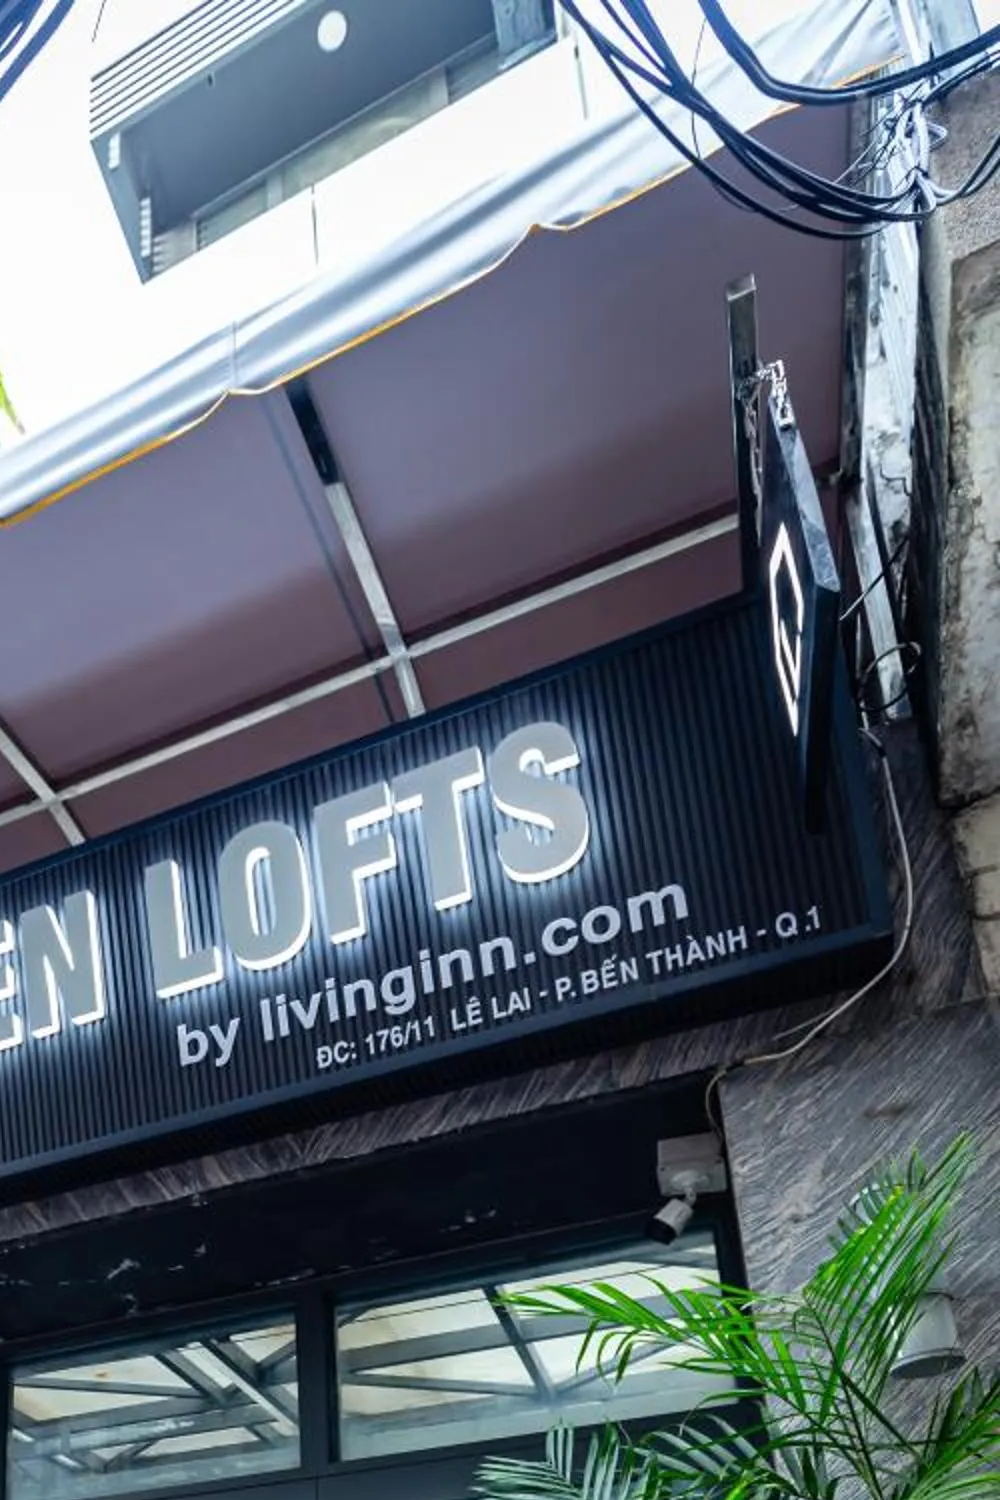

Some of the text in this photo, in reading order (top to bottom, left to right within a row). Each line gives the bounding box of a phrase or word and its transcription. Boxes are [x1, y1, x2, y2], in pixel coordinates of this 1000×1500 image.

[143, 721, 591, 1000] LOFTS
[177, 883, 689, 1067] by livinginn.com
[316, 1040, 357, 1069] ĐC:
[365, 1016, 436, 1055] 176/11
[451, 996, 483, 1032] LÊ
[492, 986, 531, 1022] LAI
[646, 924, 748, 976] THÀNH
